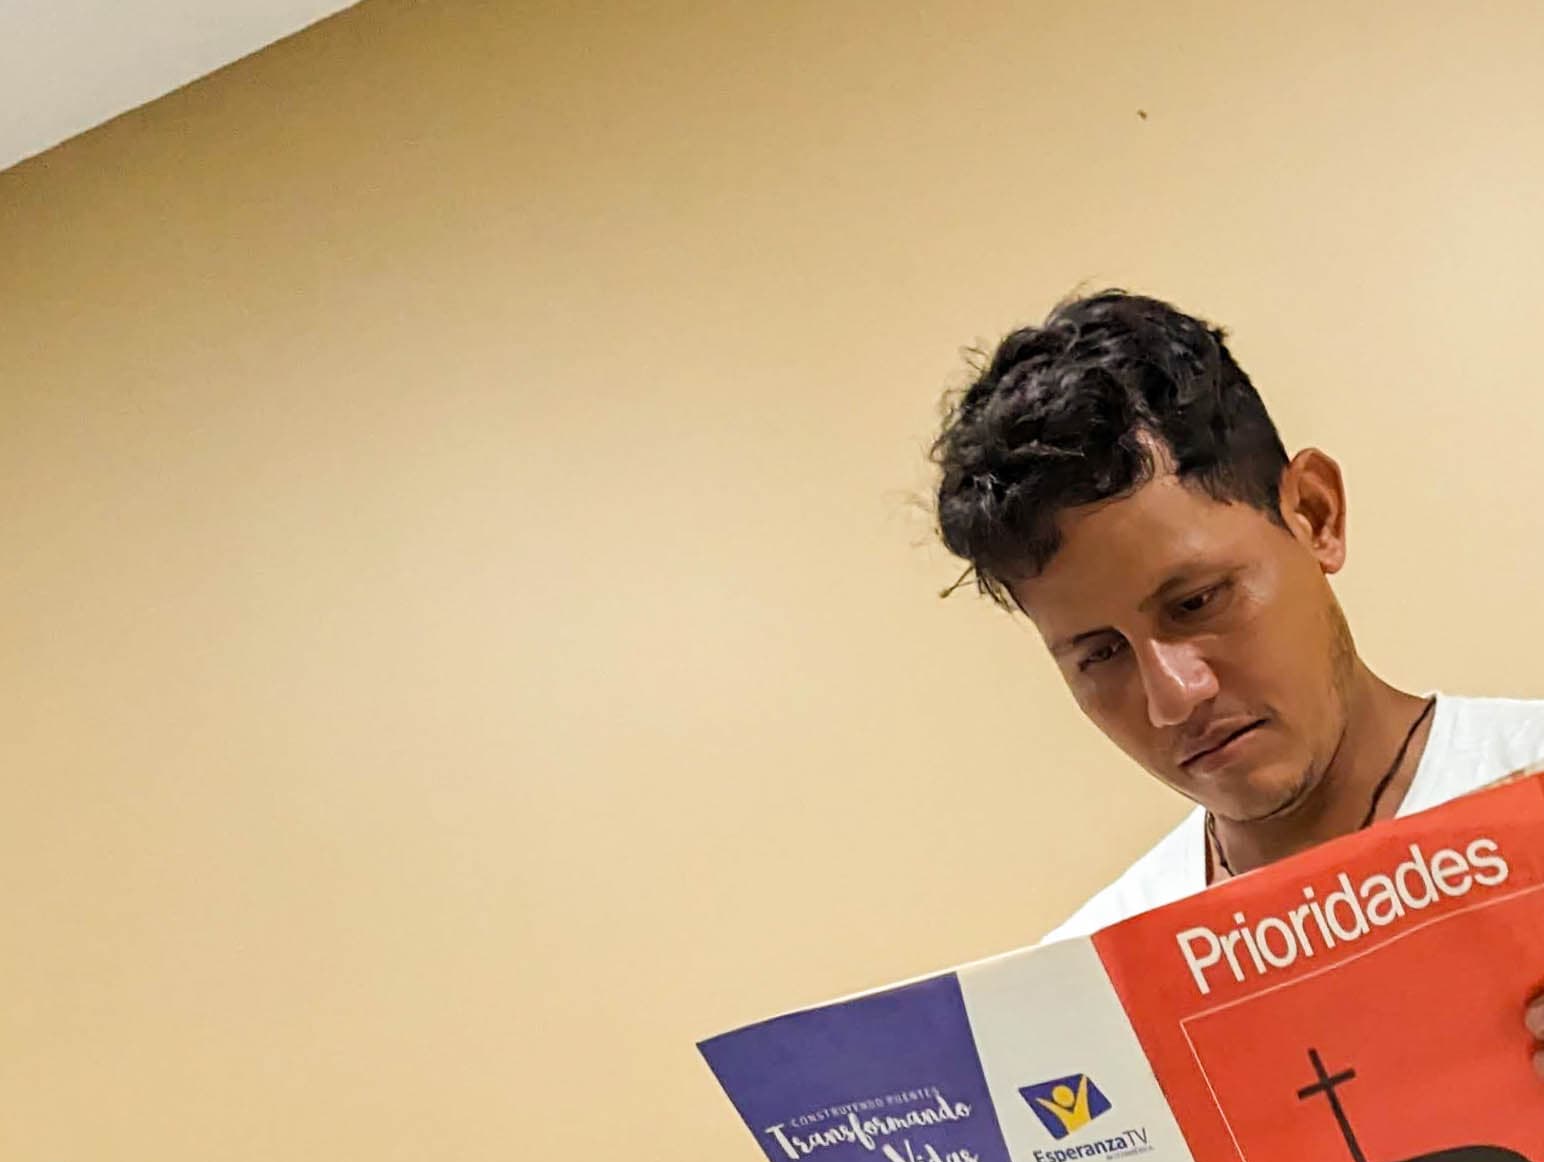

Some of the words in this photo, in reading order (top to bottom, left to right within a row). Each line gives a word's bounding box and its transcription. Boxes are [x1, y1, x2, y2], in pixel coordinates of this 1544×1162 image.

[1176, 839, 1508, 995] Prioridades
[765, 1095, 972, 1160] Transformando
[790, 1097, 886, 1129] CONSTRUYENDO
